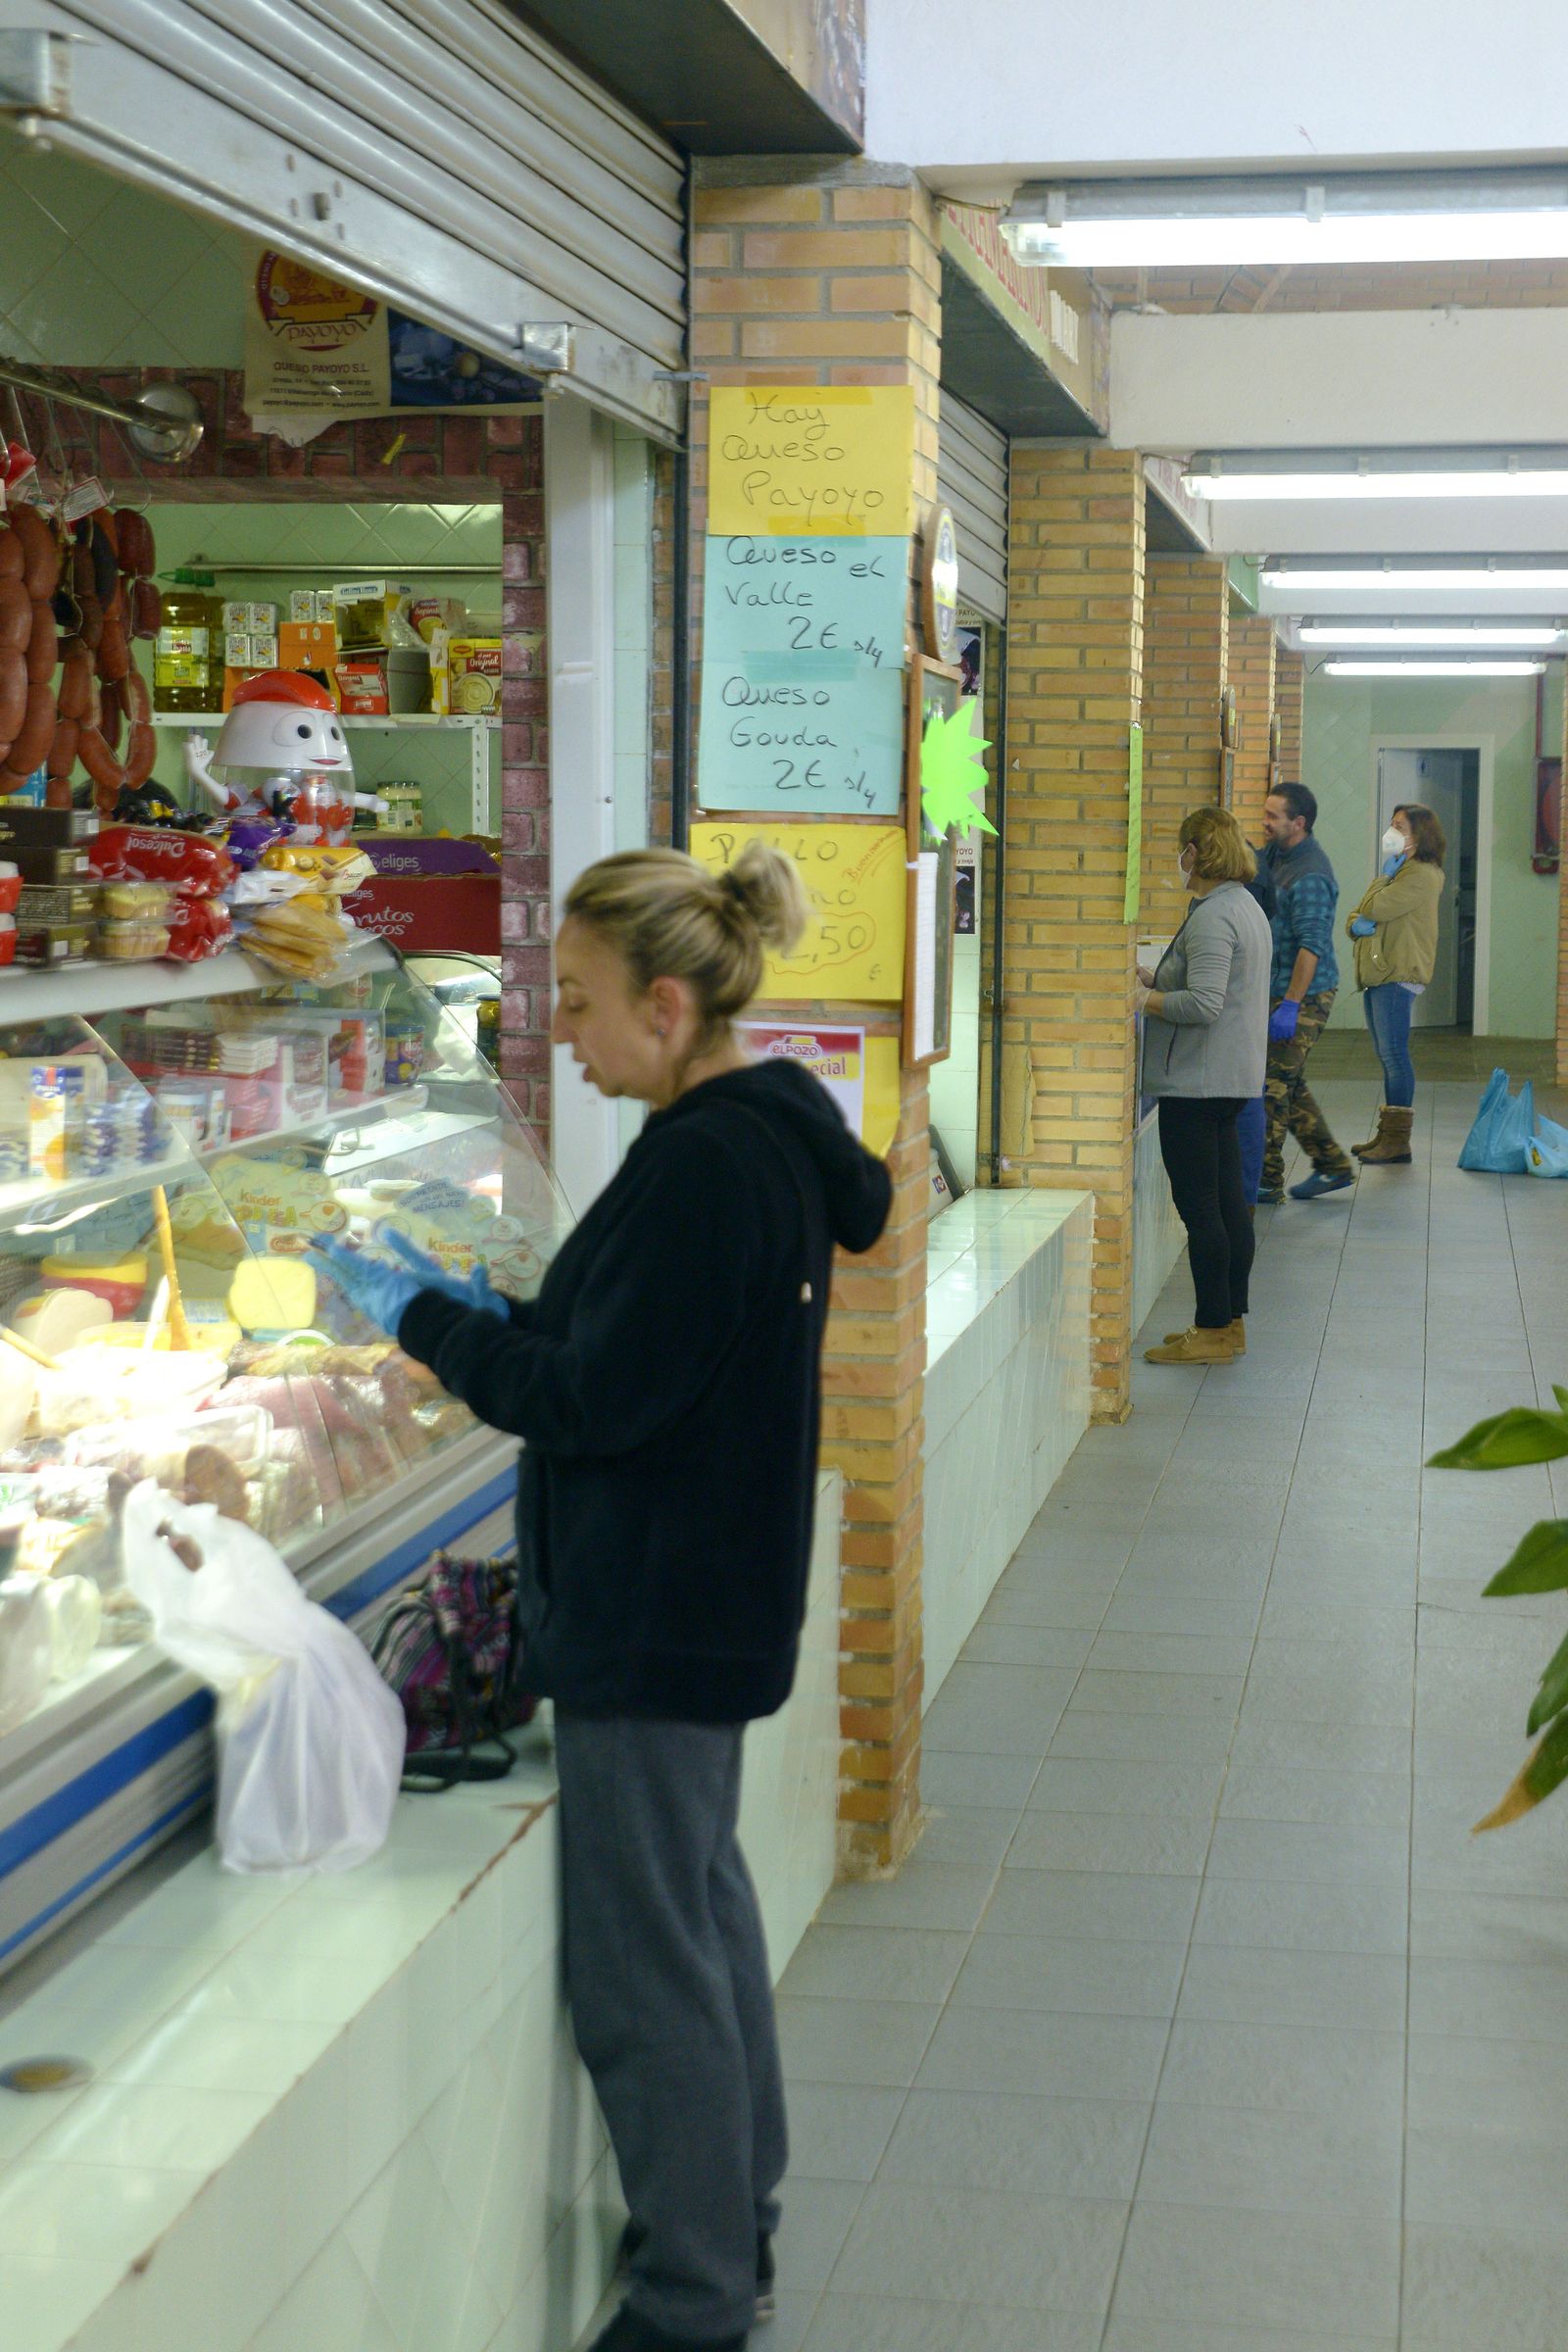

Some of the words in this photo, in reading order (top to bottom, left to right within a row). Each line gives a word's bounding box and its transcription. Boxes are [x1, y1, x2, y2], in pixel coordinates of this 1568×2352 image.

[749, 392, 830, 441] Hay
[722, 434, 845, 462] Queso
[742, 469, 884, 526] Payoyo
[726, 535, 836, 565] Queso
[725, 581, 813, 606] Valle
[469, 656, 499, 669] Original
[722, 676, 830, 707] Queso
[730, 716, 838, 747] Gouda
[126, 835, 186, 858] Dulcesol
[382, 855, 420, 871] eliges
[356, 906, 416, 927] rutos
[809, 1057, 847, 1075] ecial
